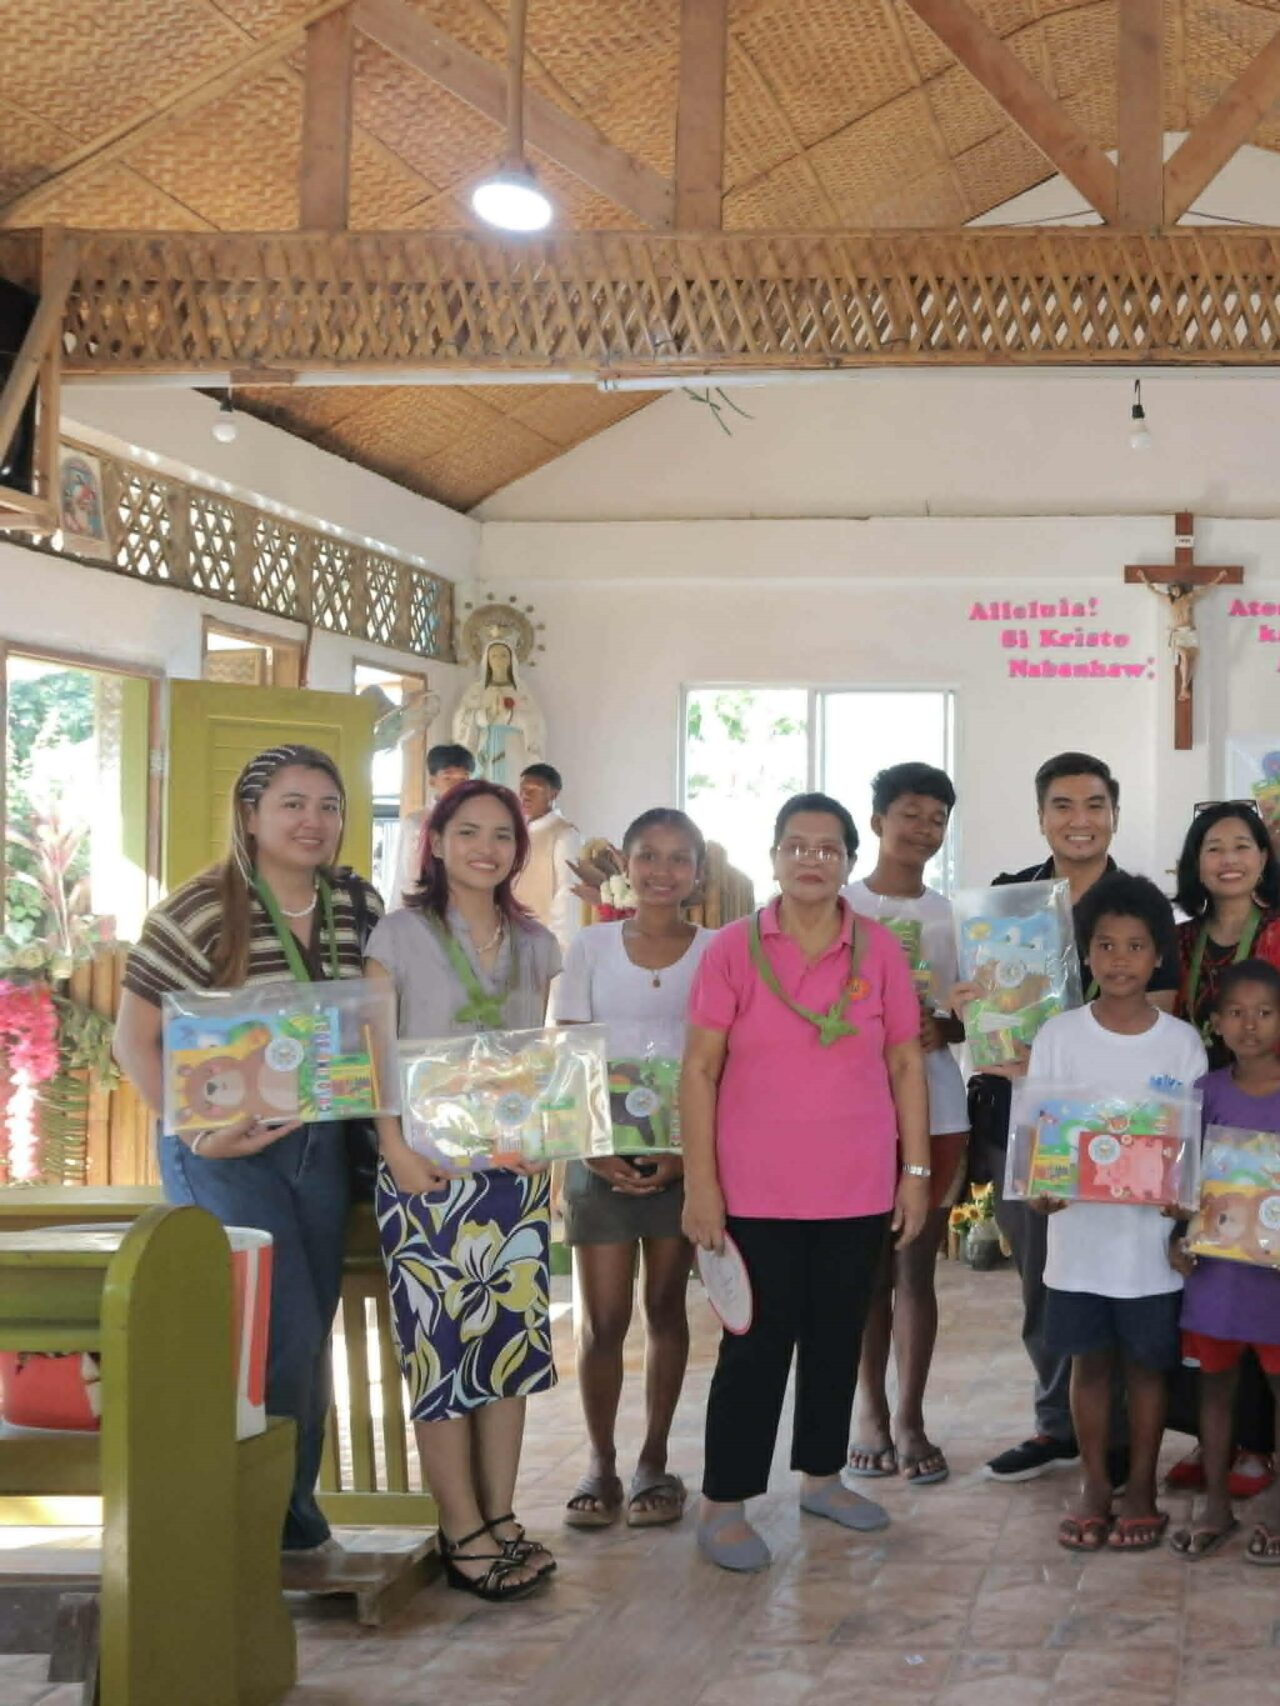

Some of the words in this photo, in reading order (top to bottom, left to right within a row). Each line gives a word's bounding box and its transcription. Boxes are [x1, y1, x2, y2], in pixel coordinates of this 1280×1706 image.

[968, 598, 1101, 621] Alleluia!
[1001, 629, 1029, 649] Si
[1038, 627, 1131, 648] Kristo
